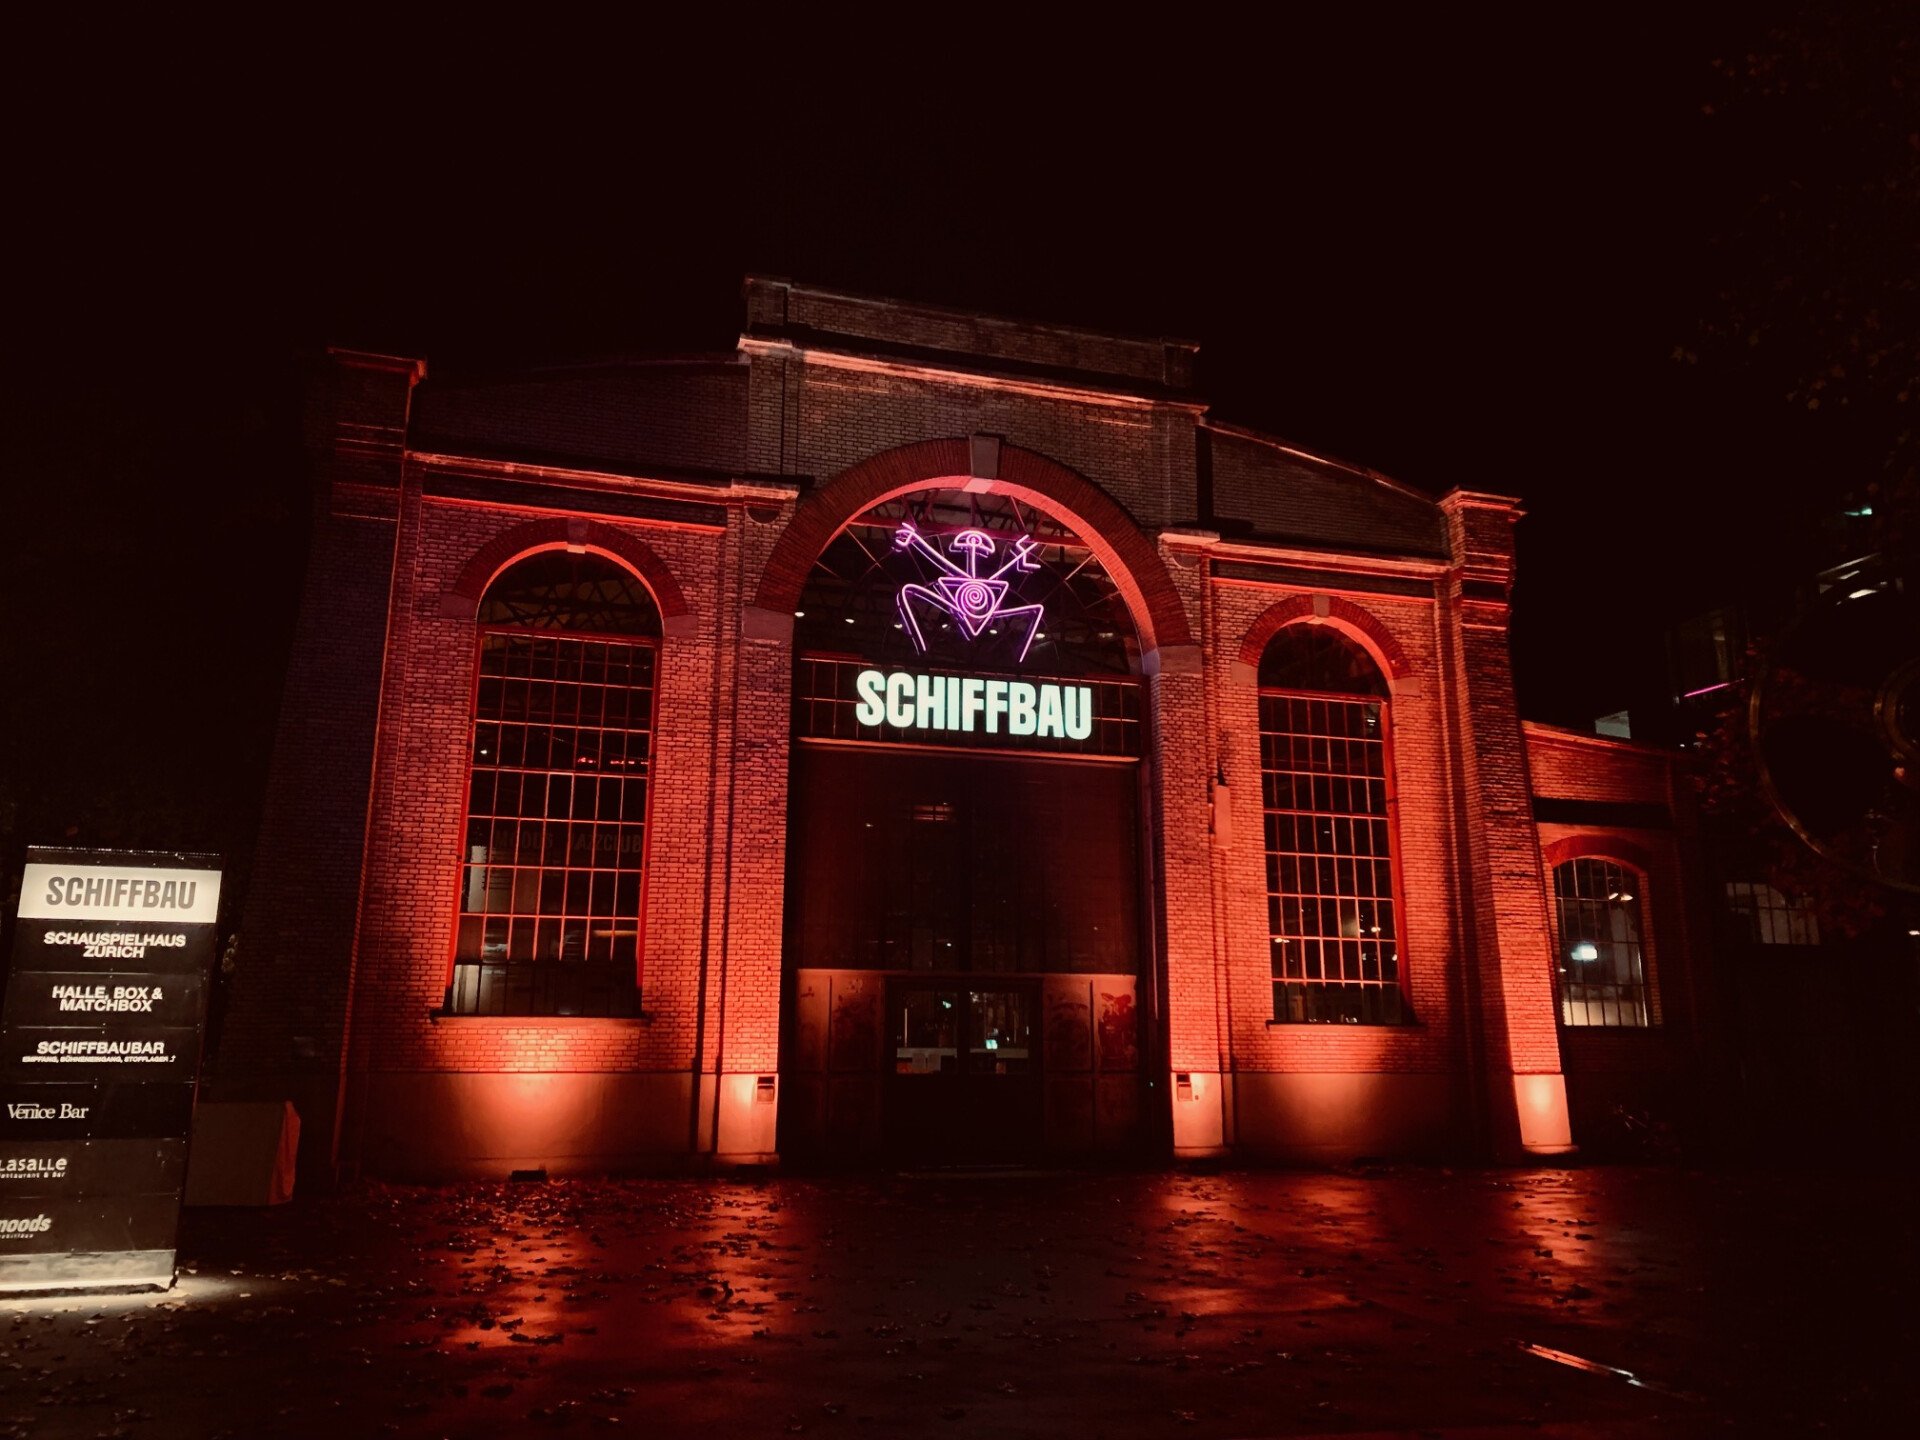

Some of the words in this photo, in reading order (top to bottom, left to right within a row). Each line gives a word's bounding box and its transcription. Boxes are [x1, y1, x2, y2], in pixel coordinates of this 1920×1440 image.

[855, 669, 1092, 740] SCHIFFBAU
[46, 876, 197, 910] SCHIFFBAU
[44, 931, 187, 948] SCHAUSPIELHAUS
[52, 985, 109, 1001] HALLE,
[114, 986, 149, 1000] BOX
[151, 987, 163, 1001] &
[59, 998, 153, 1012] MATCHBOX
[37, 1041, 165, 1055] SCHIFFBAUBAR
[7, 1103, 56, 1119] Venice
[59, 1103, 89, 1119] Bar
